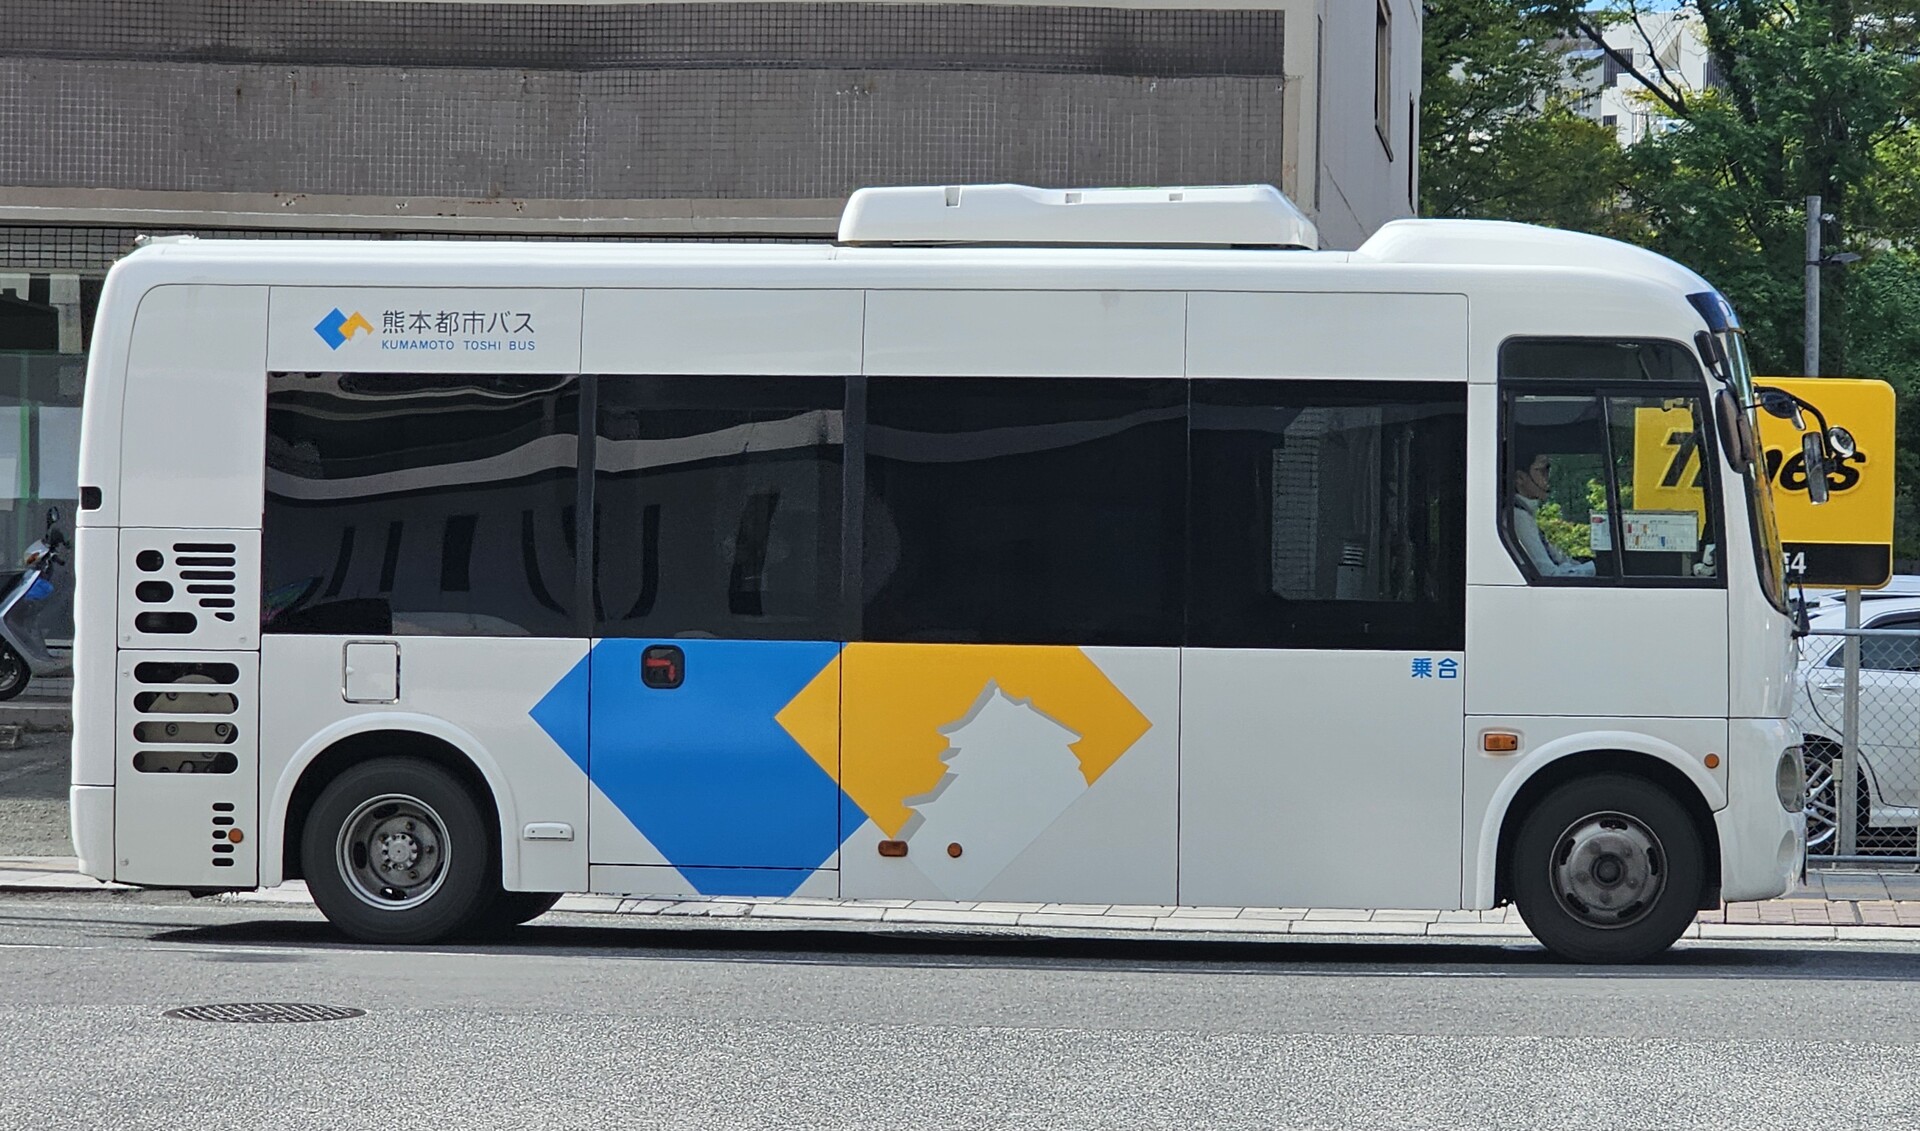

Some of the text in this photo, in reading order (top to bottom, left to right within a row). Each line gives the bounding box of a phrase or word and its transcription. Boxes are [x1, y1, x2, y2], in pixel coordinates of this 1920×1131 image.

[381, 310, 535, 336] 熊本都市バス
[381, 340, 536, 351] KUMAMOTO TOSHI BUS
[1411, 657, 1459, 679] 乗合
